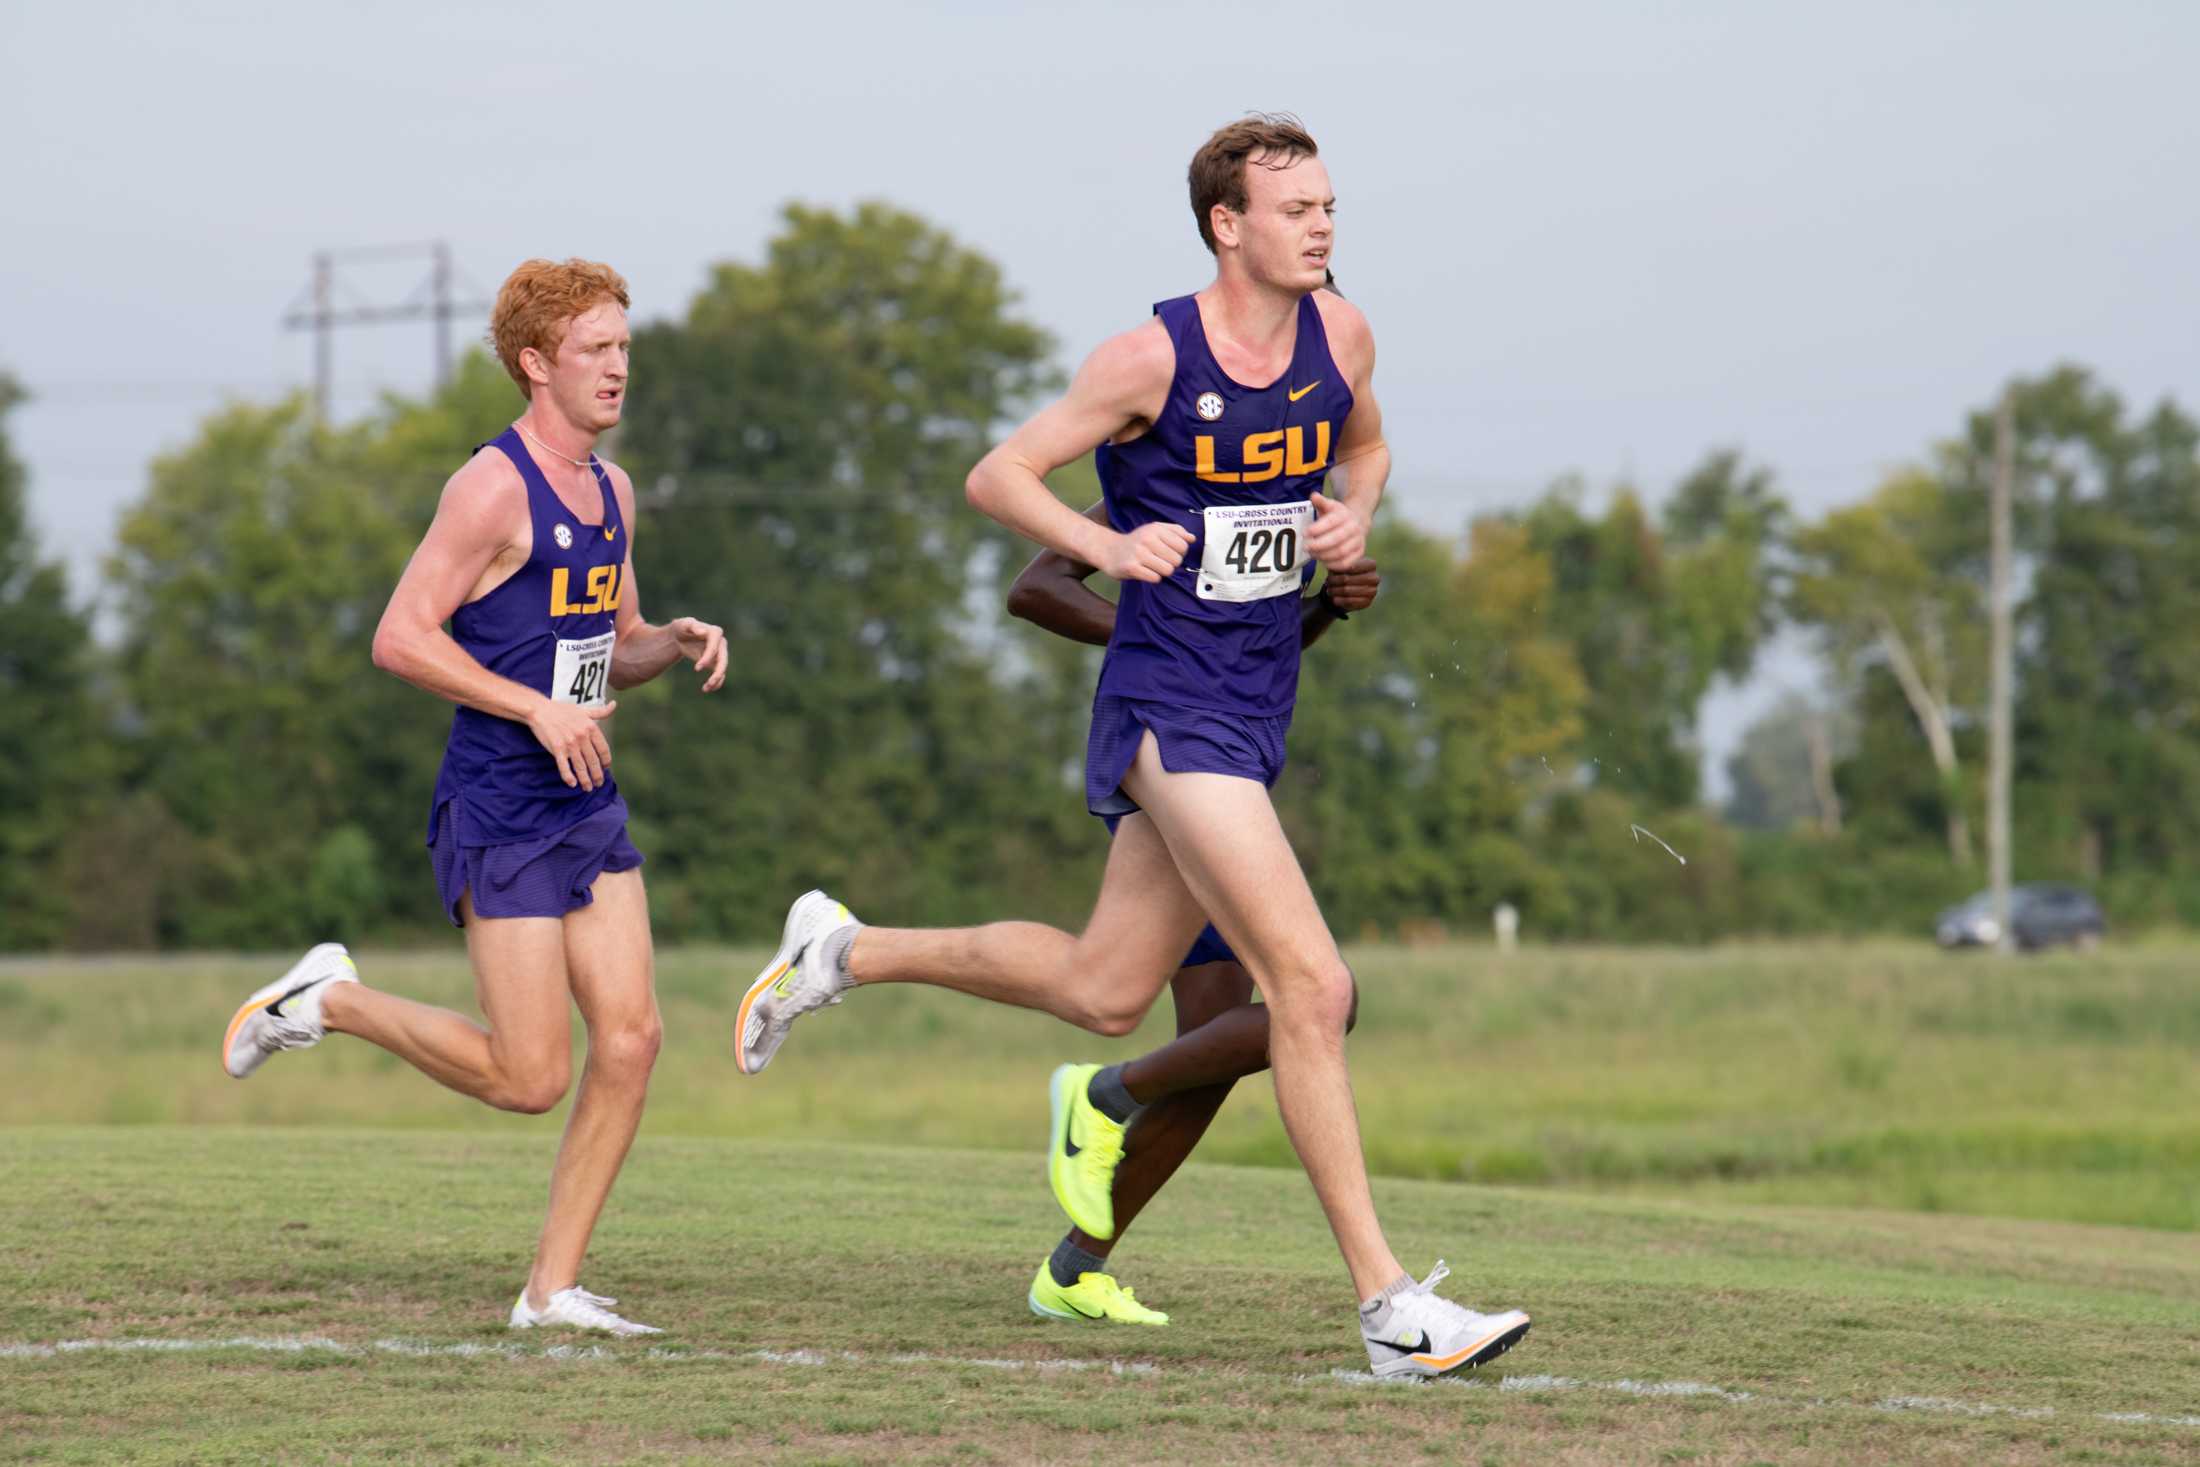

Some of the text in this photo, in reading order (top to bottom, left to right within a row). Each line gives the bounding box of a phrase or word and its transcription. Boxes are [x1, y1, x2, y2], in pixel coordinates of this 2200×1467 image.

[1195, 421, 1331, 483] LSU
[1233, 518, 1294, 529] INVITATIONAL
[1270, 505, 1308, 517] COUNTRY
[1225, 528, 1296, 574] 420
[550, 564, 624, 617] LSU
[569, 658, 606, 704] 421
